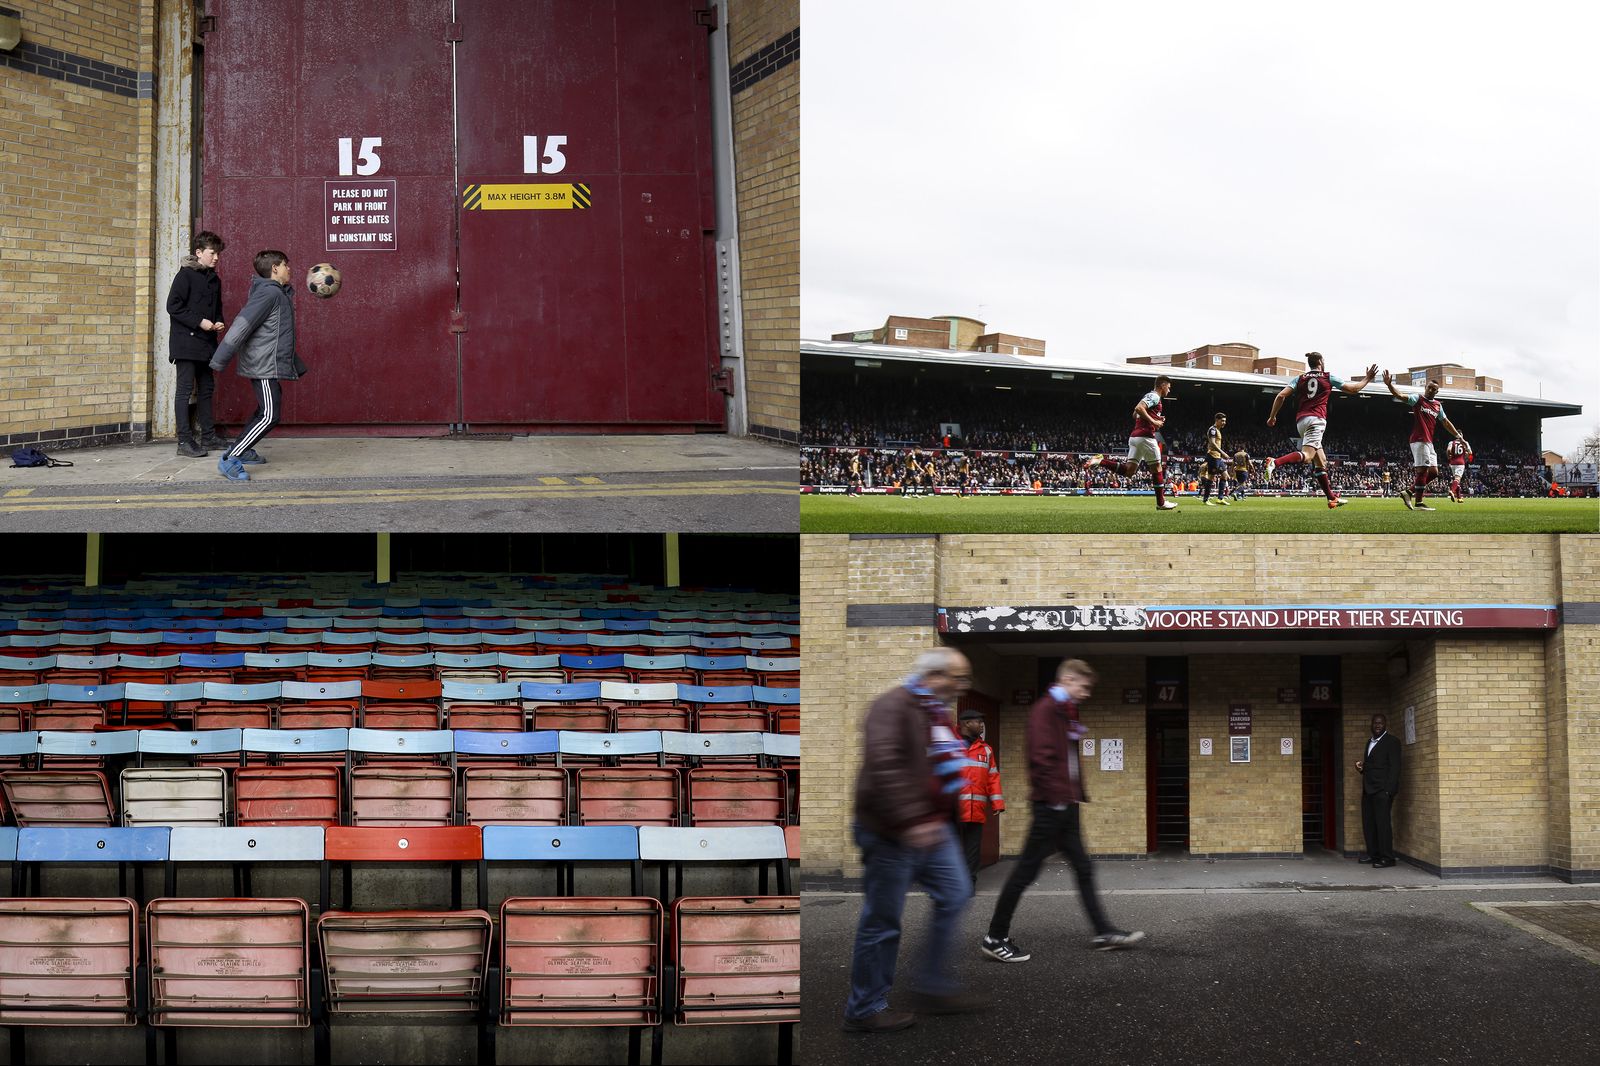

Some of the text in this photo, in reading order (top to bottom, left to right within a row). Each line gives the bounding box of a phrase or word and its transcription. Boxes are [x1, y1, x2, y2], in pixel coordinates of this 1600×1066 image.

[338, 137, 382, 176] 15
[523, 135, 568, 175] 15
[332, 189, 388, 198] PLEASE DO NOT
[487, 193, 507, 201] MAX
[544, 192, 566, 200] 3.8M
[333, 202, 388, 211] PARK IN FRONT
[331, 215, 390, 225] OF THESE GATES
[329, 232, 393, 242] IN CONSTANT USE
[1307, 377, 1318, 399] 9
[1455, 442, 1464, 455] 16
[1144, 611, 1213, 628] MOORE
[1218, 610, 1280, 628] STAND
[1283, 610, 1341, 627] UPPER
[1346, 610, 1385, 626] TIER
[1390, 610, 1464, 626] SEATING
[1159, 686, 1176, 702] 47
[1312, 686, 1330, 701] 48
